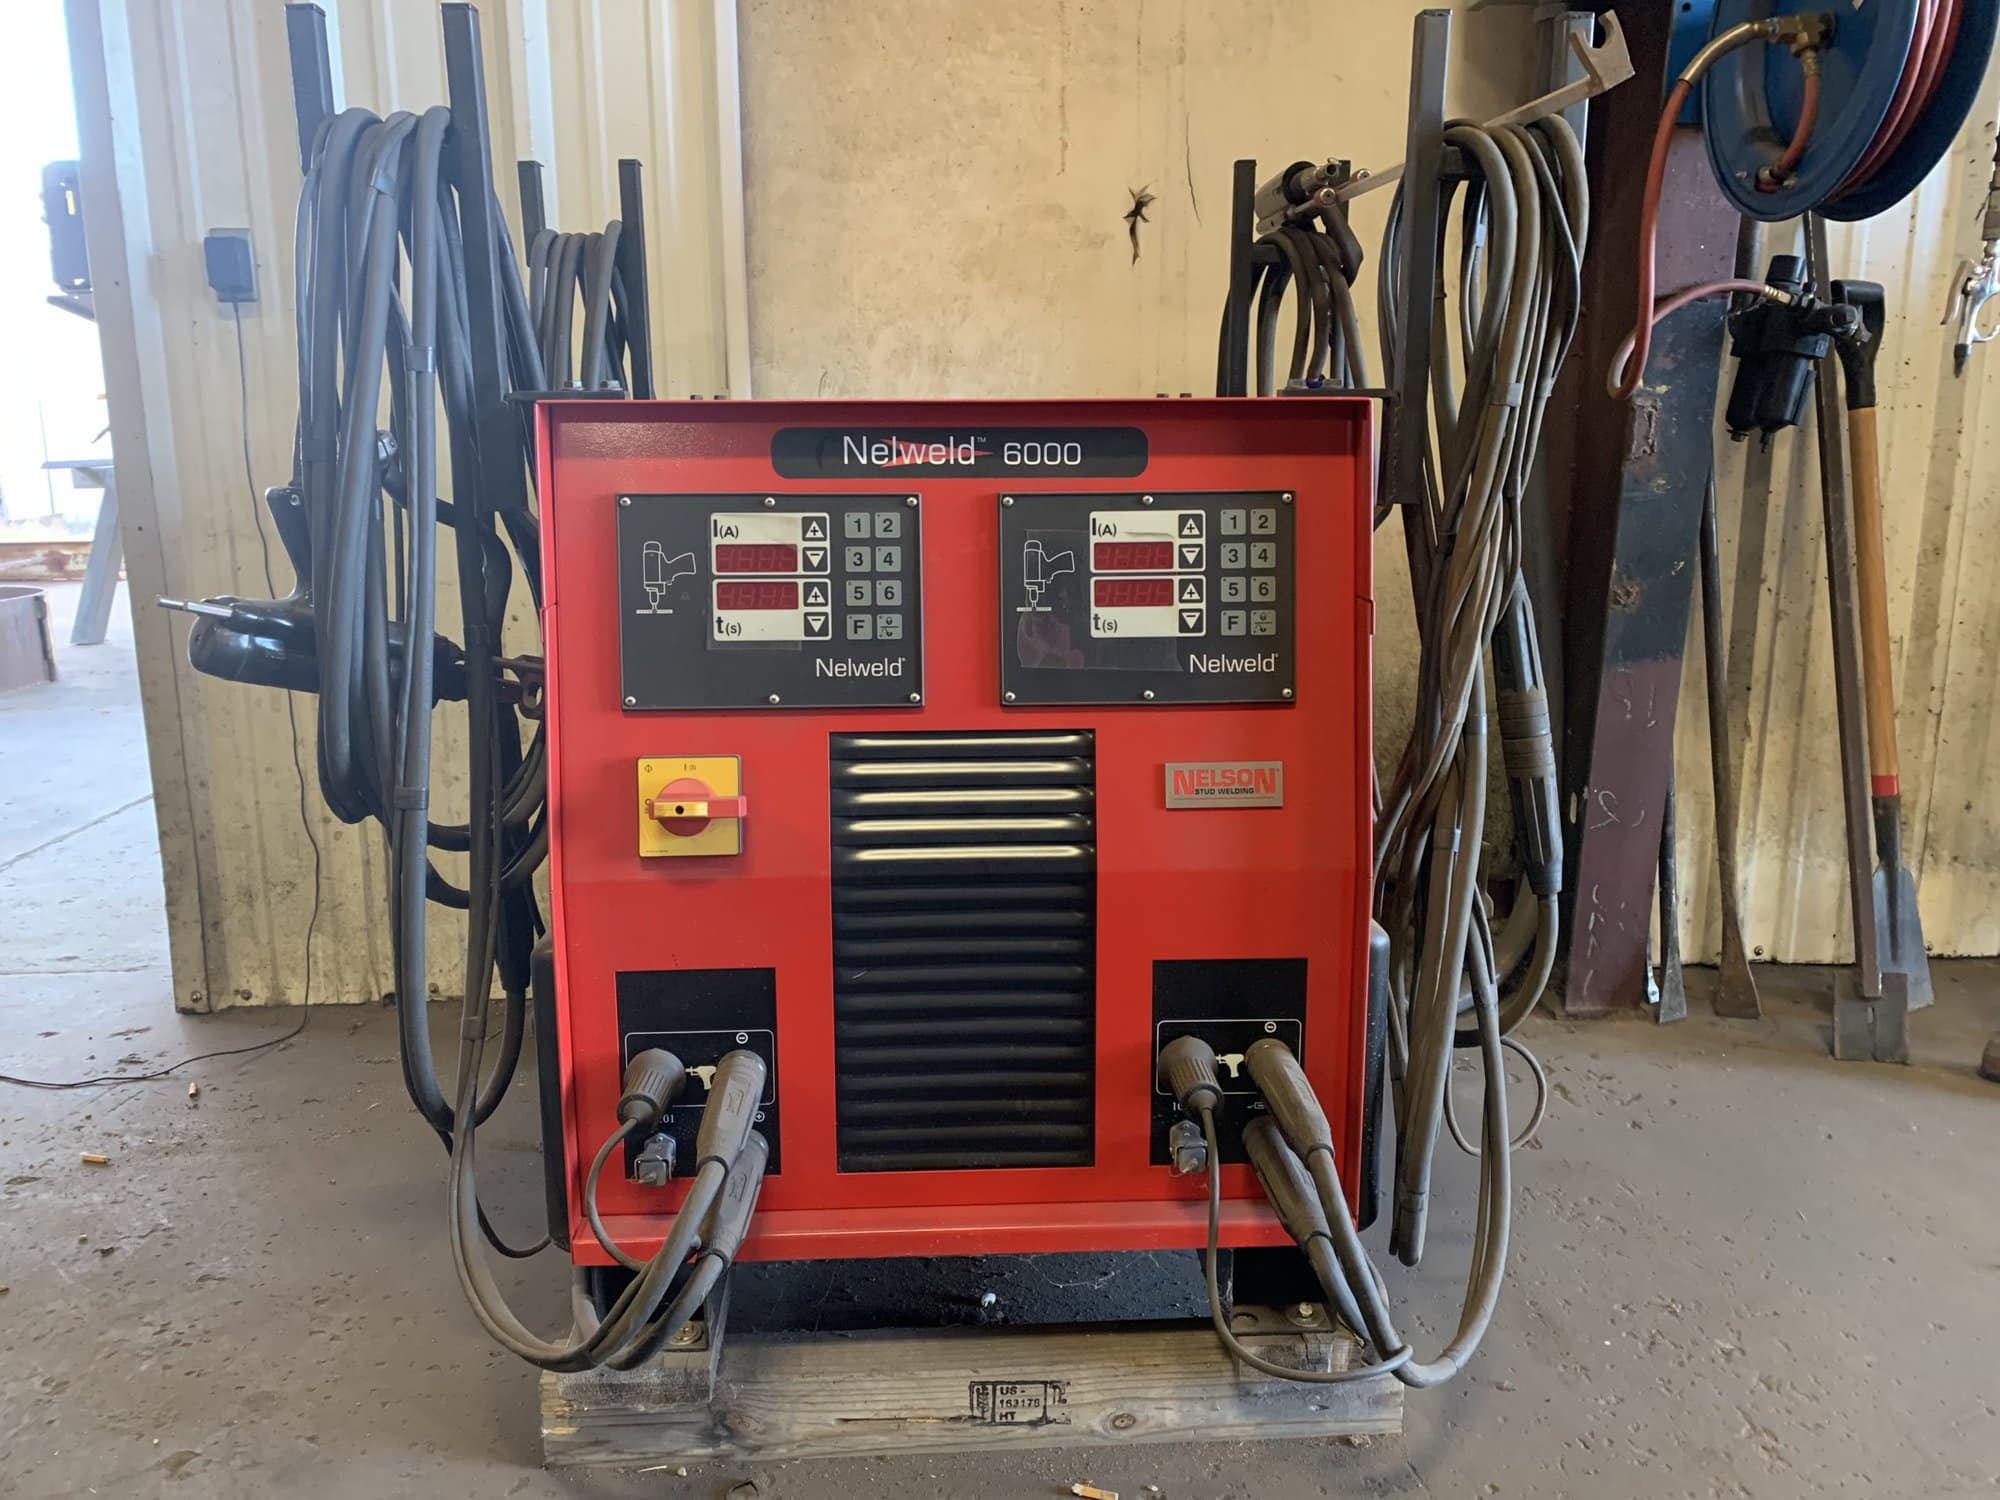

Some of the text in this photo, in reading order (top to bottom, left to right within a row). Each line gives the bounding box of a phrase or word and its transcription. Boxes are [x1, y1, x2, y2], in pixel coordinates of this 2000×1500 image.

[1003, 442, 1082, 466] 6000
[853, 518, 894, 533] 1 2
[1229, 514, 1269, 529] 1 2
[852, 551, 894, 567] 3 4
[1228, 548, 1269, 564] 3 4
[853, 586, 895, 600] 5 6
[1228, 581, 1269, 597] 5 6
[853, 619, 865, 635] F
[1227, 615, 1239, 631] F
[815, 657, 903, 678] Nelweld
[1189, 653, 1276, 673] Nelweld
[1173, 767, 1276, 795] NELSON
[1218, 787, 1254, 795] WELDING
[1000, 1386, 1018, 1396] US
[999, 1411, 1017, 1421] HT
